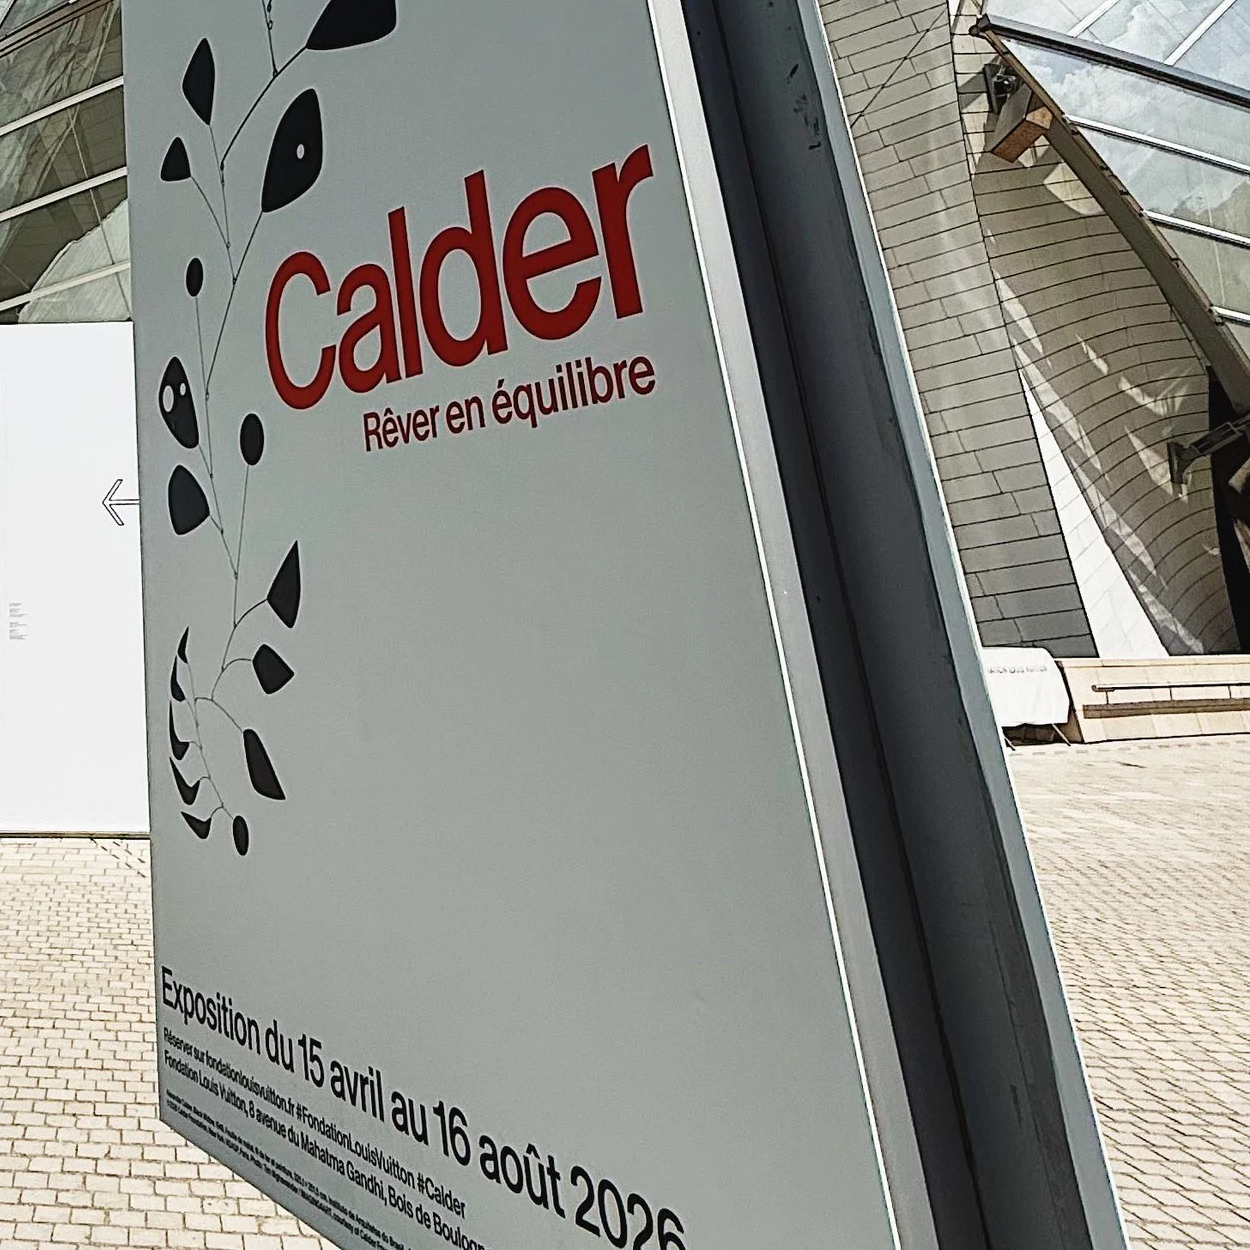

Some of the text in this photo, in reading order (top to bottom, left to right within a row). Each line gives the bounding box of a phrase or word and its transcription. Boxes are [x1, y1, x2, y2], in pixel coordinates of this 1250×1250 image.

[265, 144, 654, 410] Calder
[363, 355, 656, 452] Rêver en équilibre
[161, 966, 261, 1055] Exposition
[265, 1019, 295, 1073] du
[298, 1033, 325, 1088] 15
[330, 1060, 385, 1122] avril
[391, 1090, 429, 1146] au
[433, 1100, 471, 1166] 16
[478, 1135, 566, 1219] août
[164, 1049, 199, 1083] Fondation
[199, 1069, 219, 1097] Louis
[248, 1099, 256, 1119] 8
[256, 1108, 287, 1139] avenue
[288, 1125, 300, 1147] du
[300, 1131, 345, 1176] Mahatma
[346, 1161, 388, 1206] Gandhi,
[388, 1185, 414, 1218] Bois
[415, 1203, 432, 1230] de
[296, 1102, 415, 1189] #FondationLouisVuitton
[417, 1172, 466, 1219] #Calder
